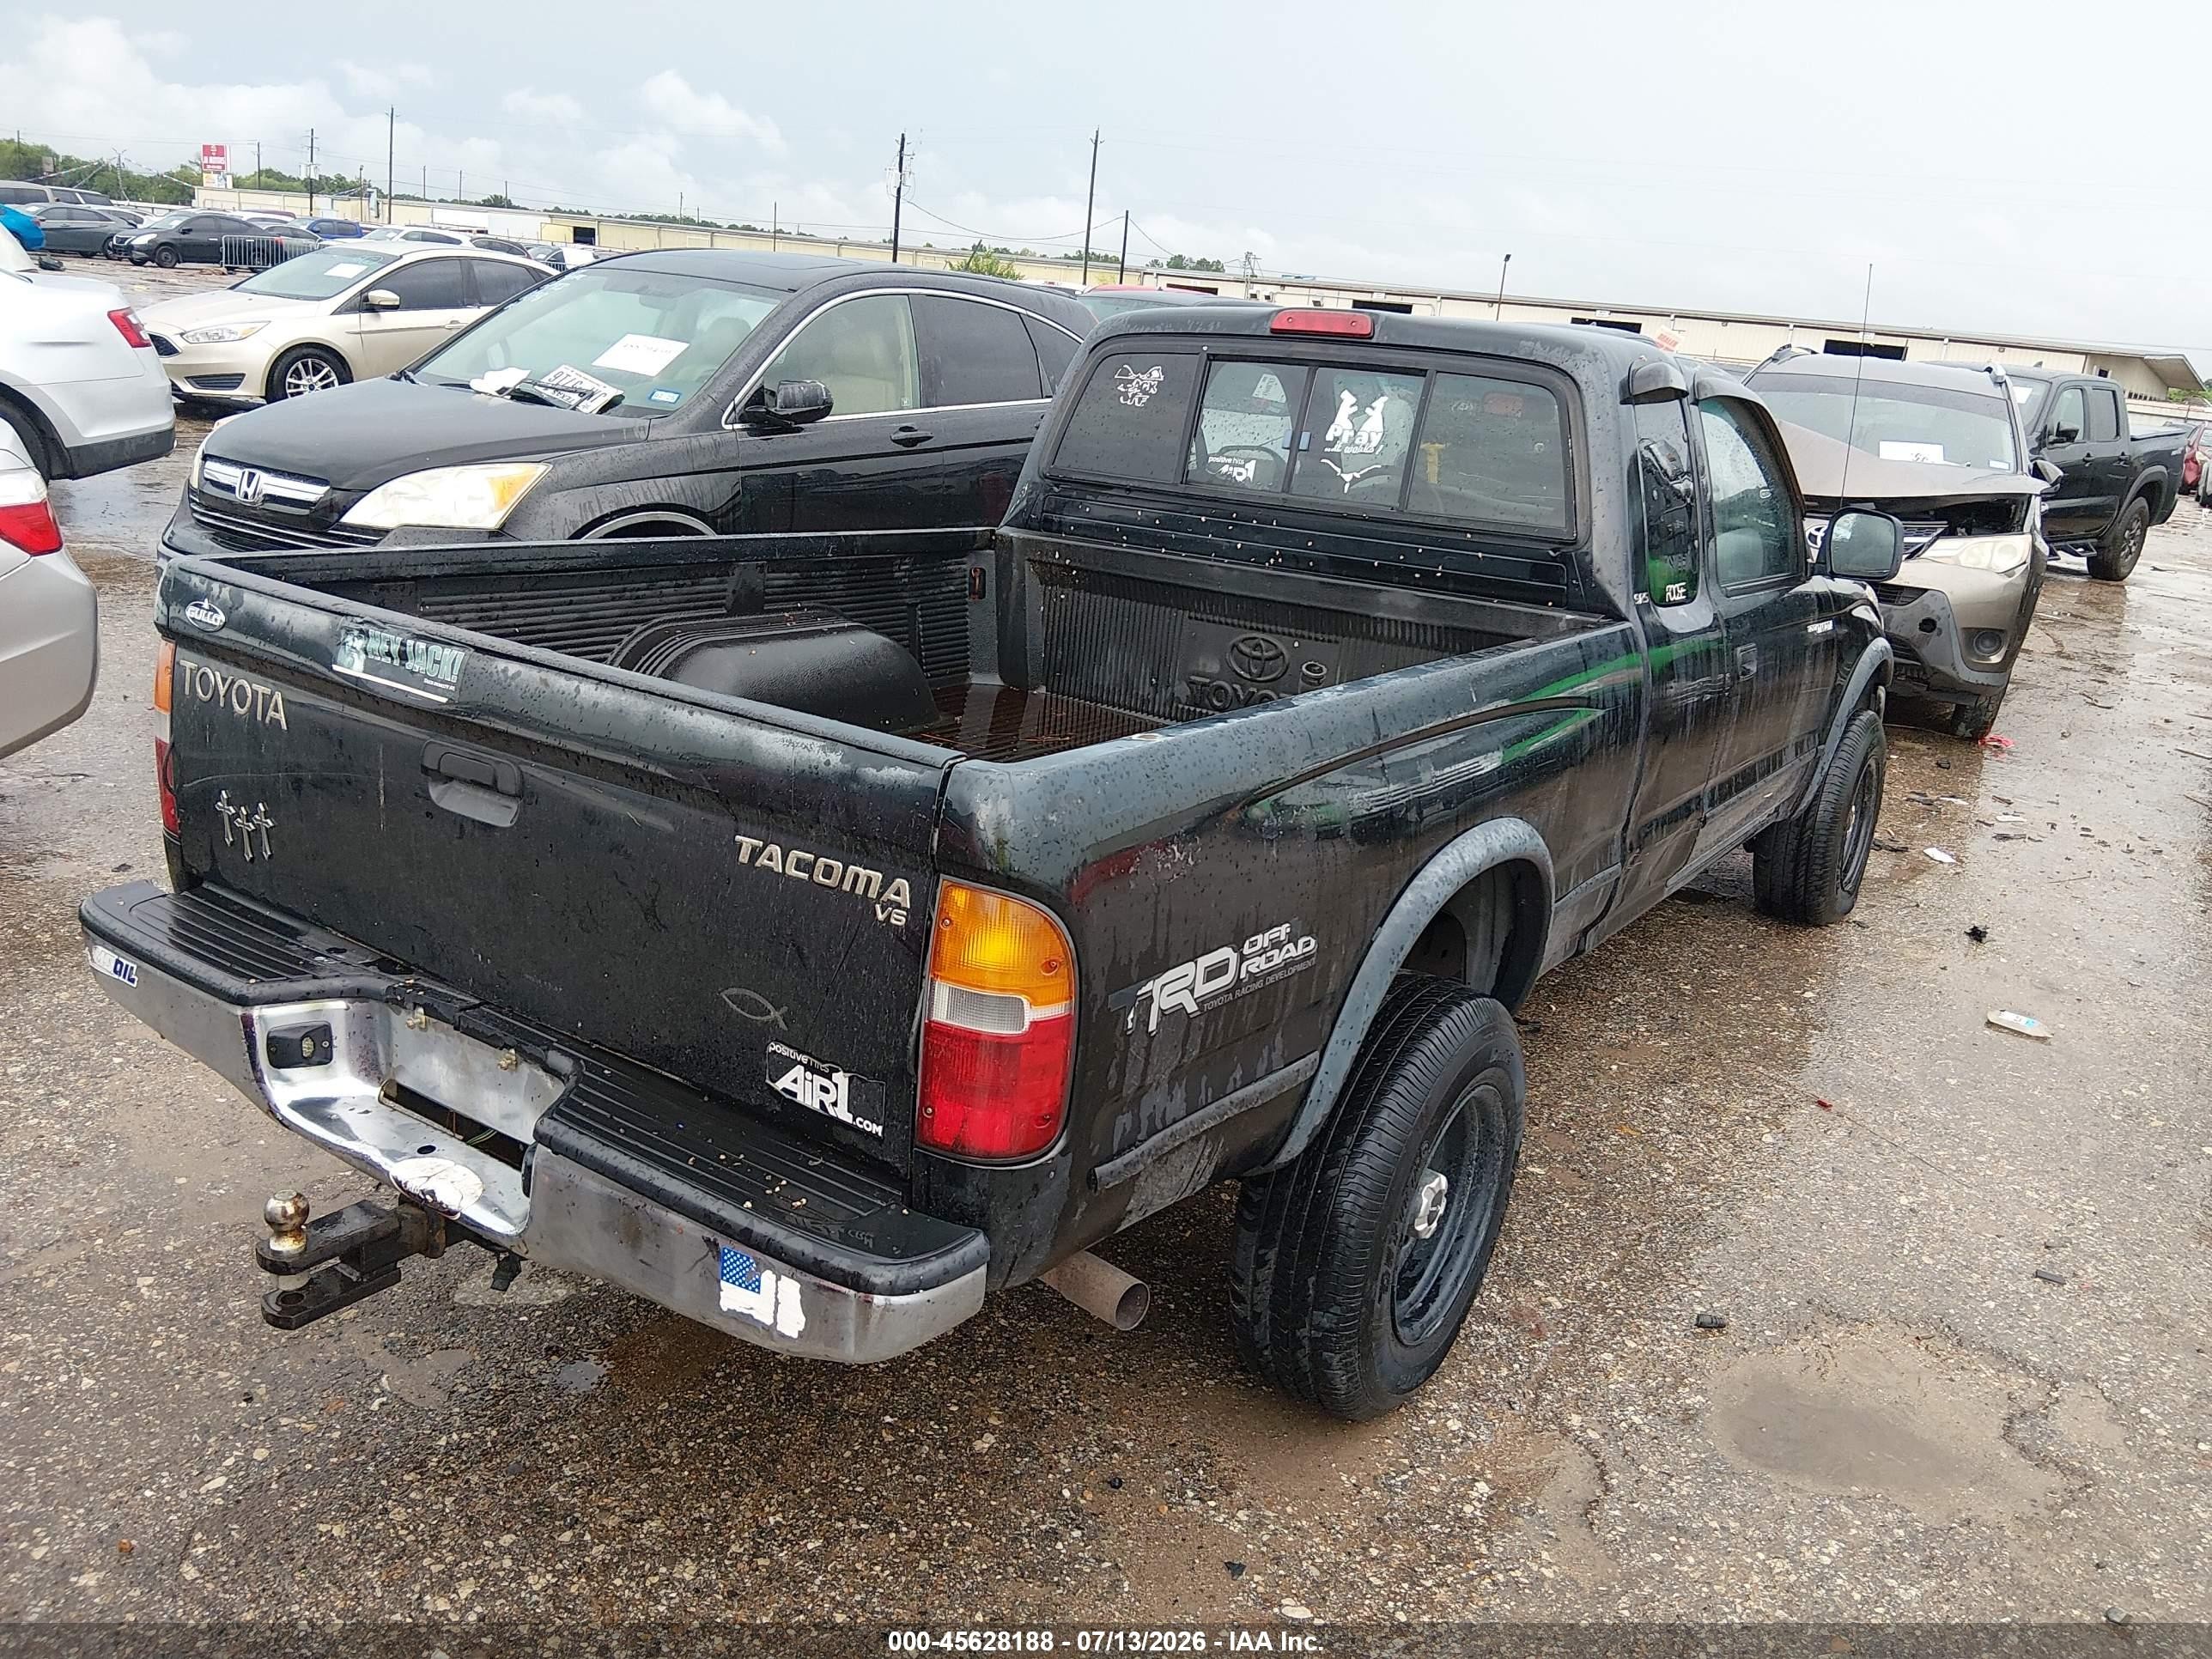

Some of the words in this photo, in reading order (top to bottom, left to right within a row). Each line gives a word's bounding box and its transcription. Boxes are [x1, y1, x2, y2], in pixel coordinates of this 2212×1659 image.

[1326, 424, 1383, 447] Pray
[367, 629, 402, 666] HEY
[405, 639, 465, 683] JACK!
[179, 659, 289, 731] TOYOTA
[734, 835, 911, 909] TACOMA
[874, 903, 908, 927] V6
[1242, 921, 1291, 956] OFF
[1239, 935, 1318, 981] ROAD
[1125, 945, 1239, 1036] TRD
[1203, 992, 1233, 1012] TOYOTA
[1234, 979, 1264, 1000] RACING
[1265, 956, 1317, 985] DEVELOPMENT
[769, 1042, 807, 1065] positive
